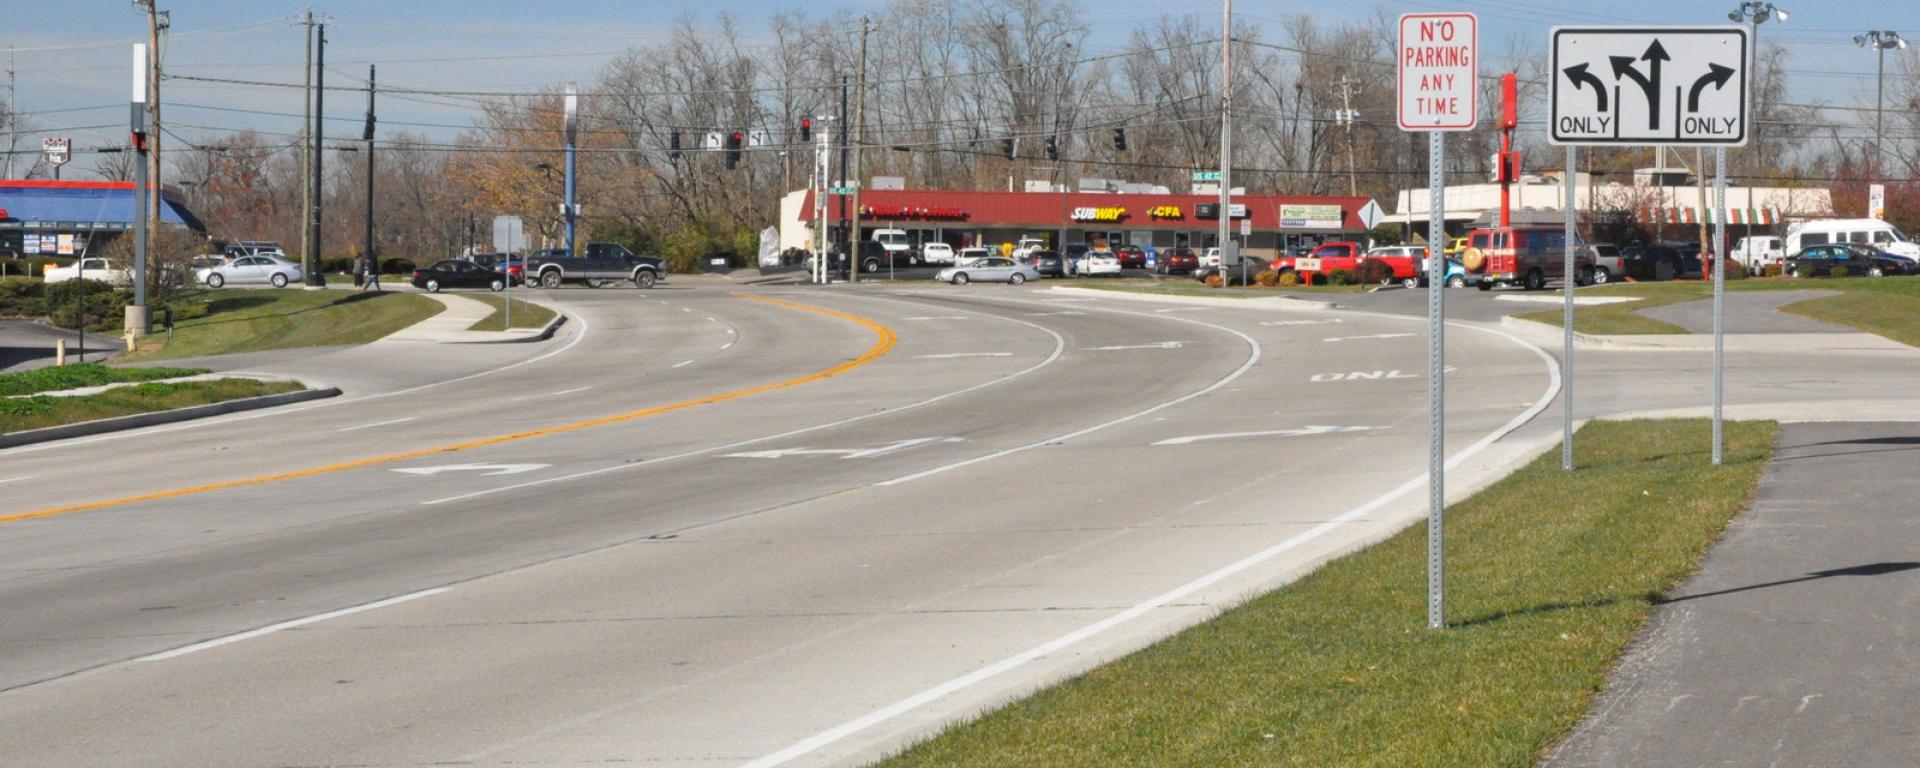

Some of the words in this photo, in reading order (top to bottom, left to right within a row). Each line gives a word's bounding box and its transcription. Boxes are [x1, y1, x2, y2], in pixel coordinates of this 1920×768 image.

[1420, 20, 1454, 42] NO
[1406, 46, 1469, 67] PARKING
[1420, 74, 1454, 91] ANY
[1416, 97, 1458, 115] TIME
[1560, 116, 1611, 134] ONLY
[1685, 117, 1736, 134] ONLY
[1070, 207, 1125, 220] SUBWAY
